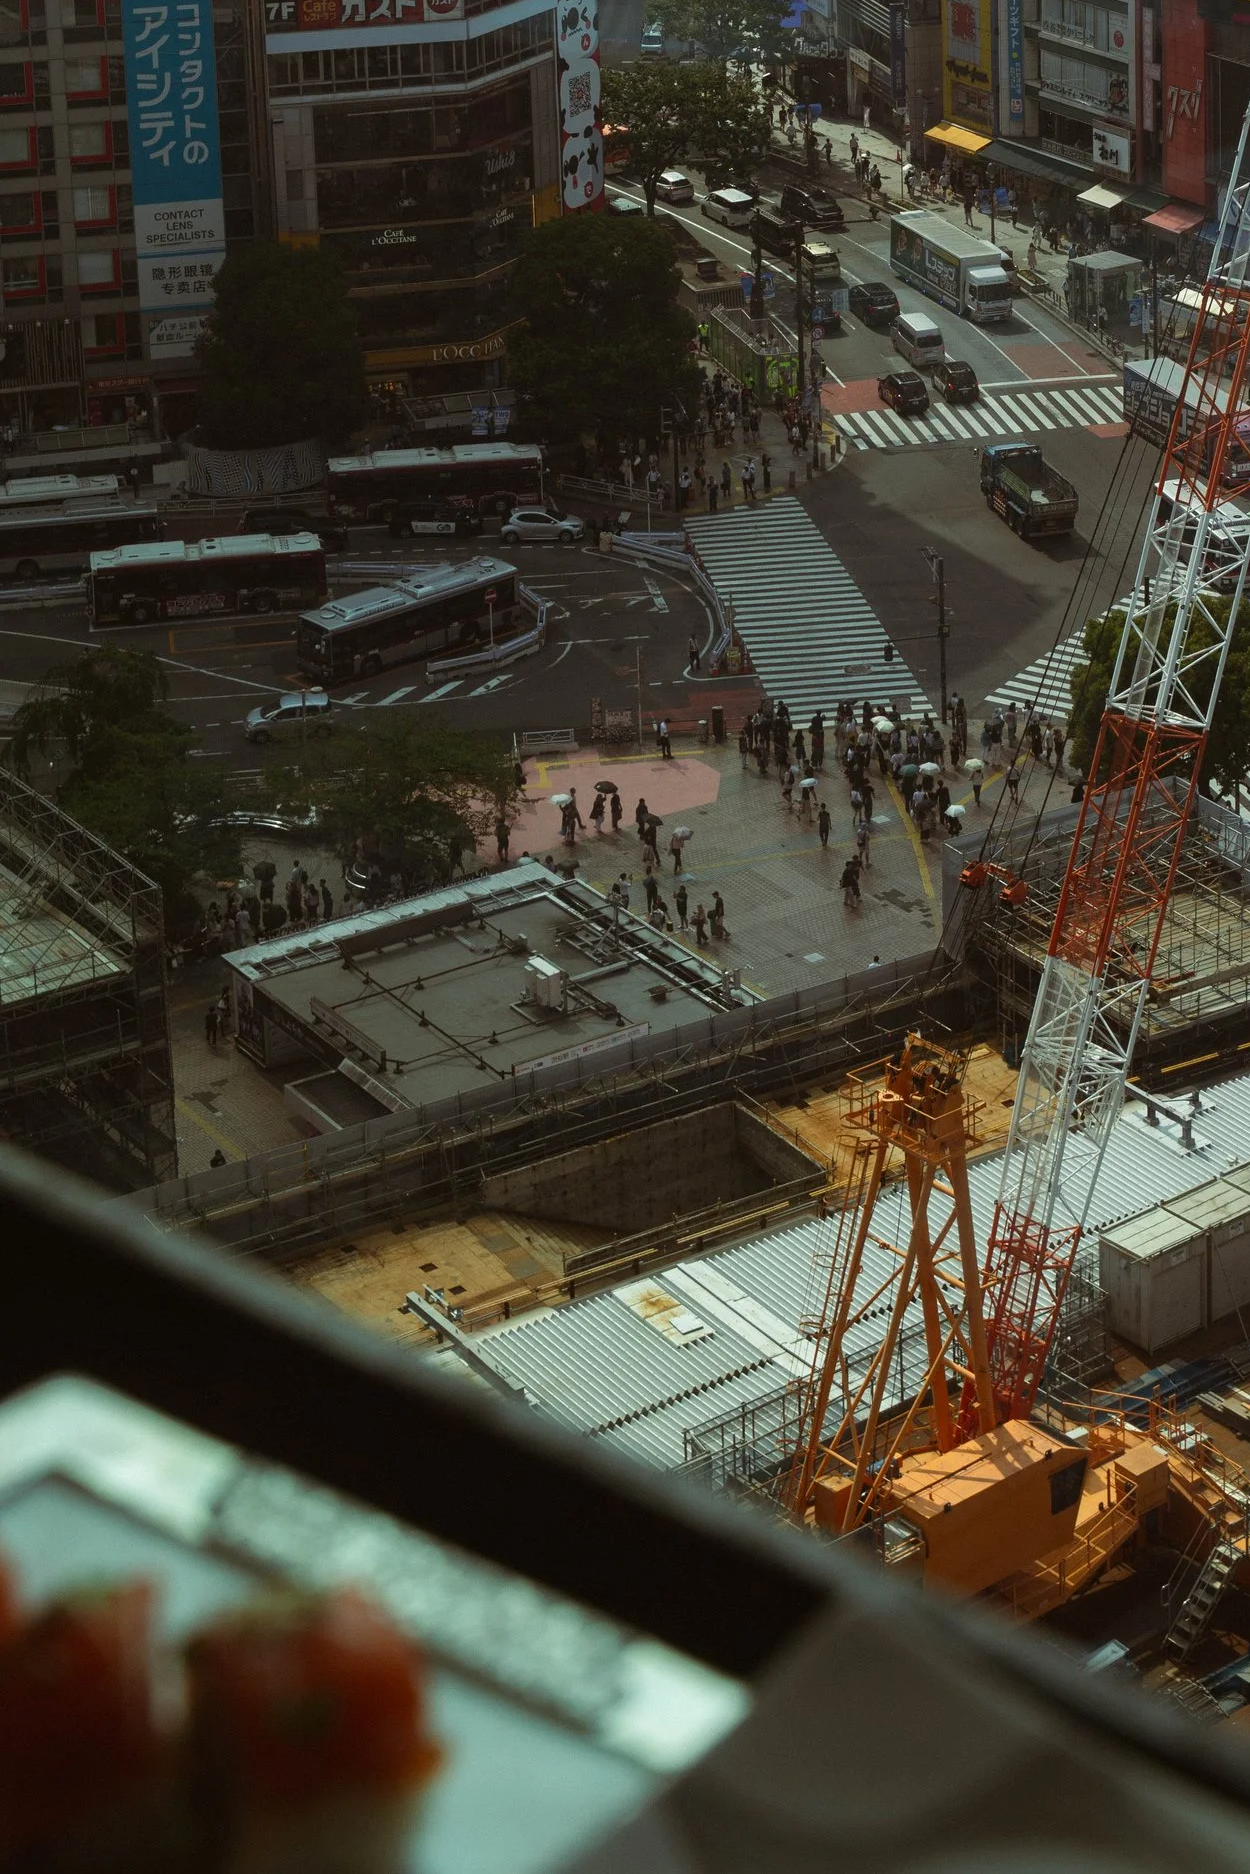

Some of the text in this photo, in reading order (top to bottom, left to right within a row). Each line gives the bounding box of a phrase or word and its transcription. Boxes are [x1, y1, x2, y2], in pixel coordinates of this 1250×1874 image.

[266, 2, 296, 21] 7F
[133, 5, 175, 168] アイシティ
[178, 4, 209, 166] コンタクトの
[154, 209, 204, 221] CONTACT
[166, 221, 193, 231] LENS
[146, 230, 215, 244] SPECIALISTS
[161, 281, 206, 294] 专卖店
